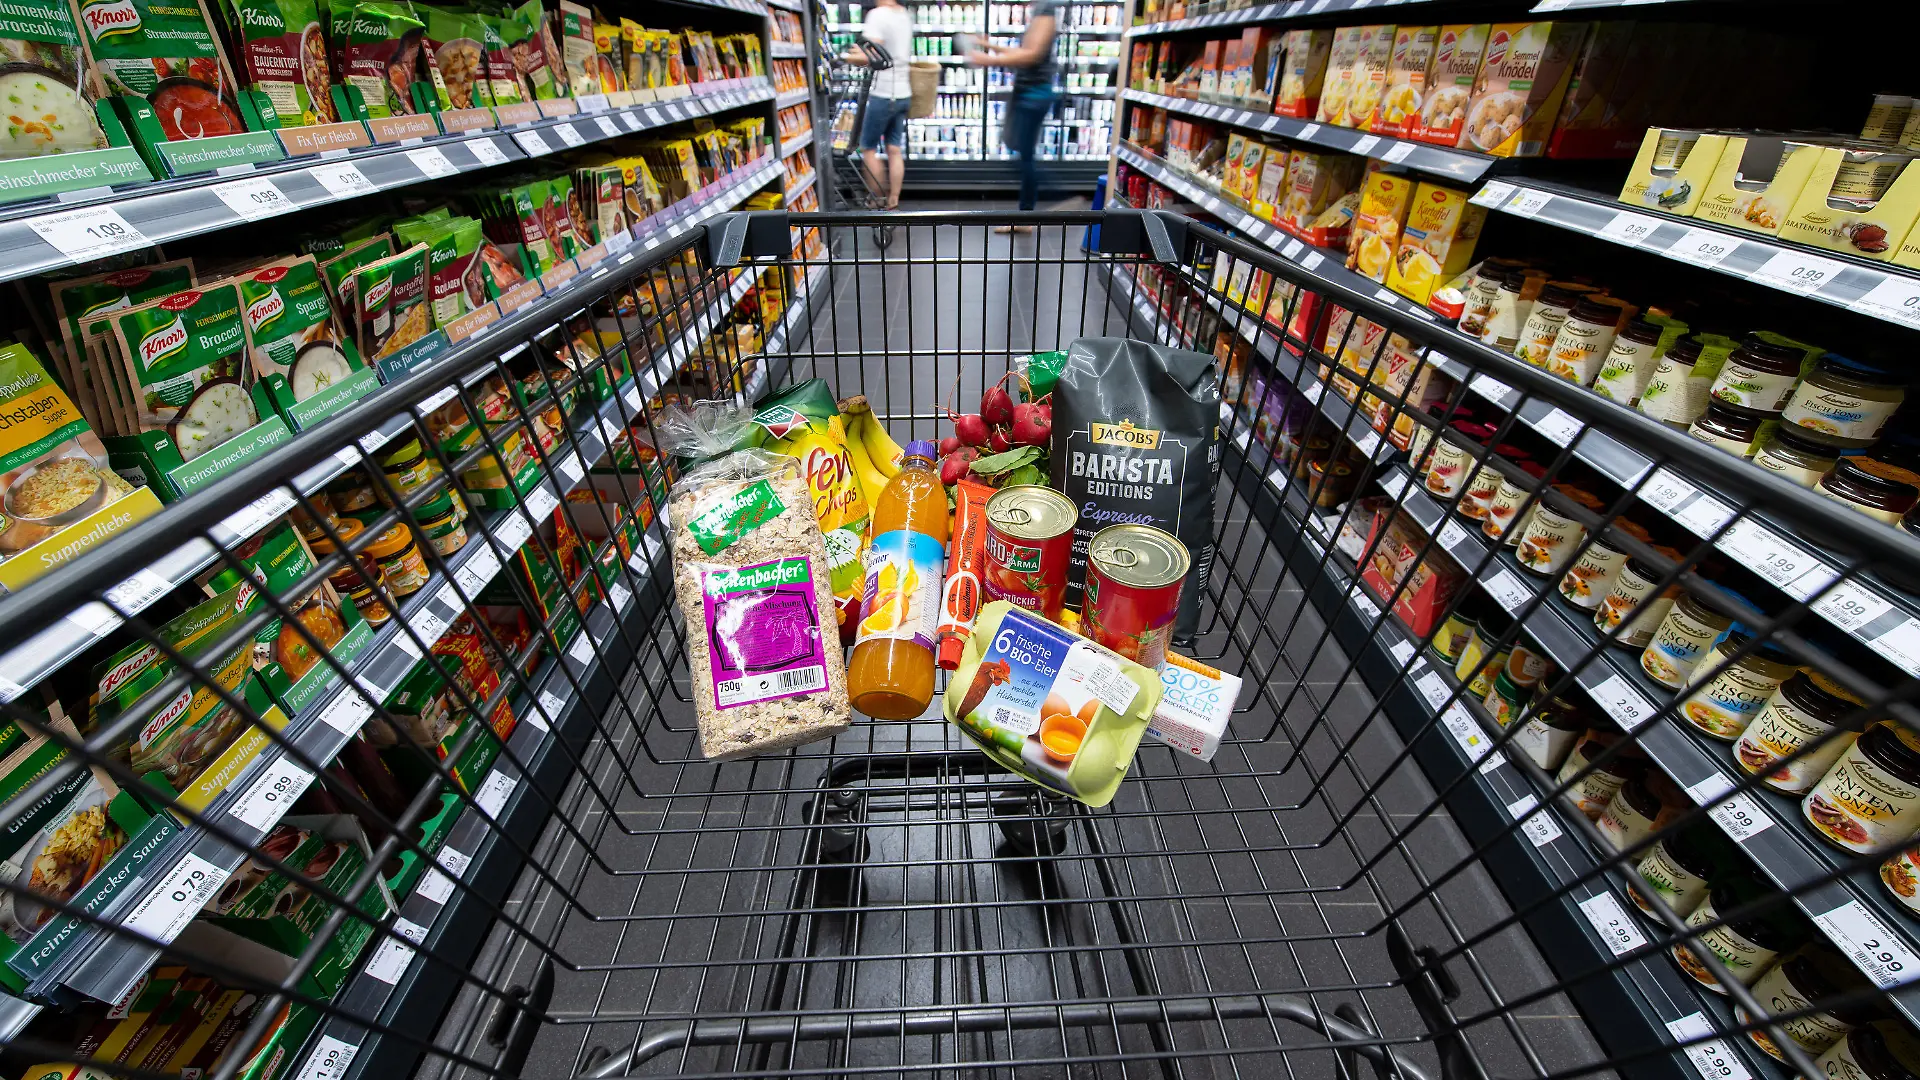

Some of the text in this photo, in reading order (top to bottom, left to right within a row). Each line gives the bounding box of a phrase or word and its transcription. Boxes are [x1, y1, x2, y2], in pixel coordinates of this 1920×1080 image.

[86, 7, 137, 30] Knorr
[242, 8, 285, 29] Knorr
[354, 19, 389, 36] Knorr
[145, 28, 210, 40] Strauchtomaten
[254, 55, 299, 69] BAUERNTOPF
[1402, 57, 1426, 72] Knödel
[1459, 50, 1481, 58] Semmel
[1513, 50, 1540, 60] Semmel
[1448, 60, 1476, 75] Knödel
[1500, 62, 1536, 79] Knödel
[297, 129, 357, 147] Fix für Fleisch
[382, 120, 429, 135] Fix für Fleisch
[171, 142, 277, 166] Feinschmecker Suppe
[0, 160, 142, 191] einschmecker Suppe
[339, 172, 362, 184] 0.79
[251, 190, 279, 204] 0.99
[1417, 201, 1451, 220] Kartoffel
[1700, 202, 1745, 217] KRUSTENTIER-
[1709, 210, 1728, 220] PASTE
[86, 222, 125, 239] 1.09
[1625, 224, 1647, 235] 0.99
[1786, 220, 1843, 237] BRATEN-PASTE
[431, 248, 457, 264] Knorr
[1698, 243, 1725, 256] 0.99
[1791, 266, 1825, 282] 0.99
[367, 281, 392, 304] Knorr
[249, 298, 283, 324] Knorr
[456, 325, 466, 336] Fix
[475, 310, 493, 327] Fleisch
[142, 328, 185, 360] Knorr
[200, 322, 241, 350] Broccoli
[390, 338, 439, 374] Fix für Gemüse
[1739, 380, 1763, 392] FOND
[299, 375, 375, 425] Feinschmecker Suppe
[1804, 398, 1862, 421] FISCH FOND
[42, 407, 68, 425] Suppe
[6, 457, 19, 466] mit
[20, 446, 41, 461] vielen
[67, 424, 80, 435] A-Z
[1096, 426, 1154, 446] JACOBS
[182, 425, 285, 487] Feinschmecker Suppe
[1072, 451, 1174, 486] BARISTA
[1087, 480, 1154, 500] EDITIONS
[1655, 484, 1678, 500] 1.99
[816, 486, 857, 520] Chips
[1081, 501, 1155, 526] Espresso
[41, 510, 133, 569] Suppenliebe
[1766, 552, 1796, 573] 1.99
[462, 573, 477, 588] 1.79
[763, 600, 802, 613] Mischung
[1003, 592, 1036, 605] STÜCKIG
[1507, 591, 1523, 606] 2.99
[1832, 594, 1866, 615] 1.99
[421, 615, 438, 632] 1.79
[995, 629, 1052, 660] 6 frische
[1657, 633, 1687, 658] FOND
[1660, 621, 1701, 655] FISCH
[102, 646, 158, 692] Knorr
[1010, 647, 1056, 678] BIO-Eier
[719, 680, 741, 693] 750g
[1032, 680, 1046, 691] dem
[1161, 667, 1224, 704] 30%
[1709, 677, 1767, 706] FISCH
[1617, 698, 1639, 719] 2.99
[1710, 689, 1751, 712] FOND
[143, 692, 191, 739] Knorr
[201, 731, 266, 796] Suppenliebe
[473, 748, 490, 774] Soße
[67, 770, 87, 792] Sauce
[265, 776, 292, 802] 0.89
[495, 775, 508, 792] 1.29
[1834, 764, 1904, 818] ENTEN
[1833, 783, 1878, 818] FOND
[1723, 802, 1753, 828] 2.99
[1530, 817, 1548, 836] 2.99
[133, 825, 171, 864] Sauce
[172, 870, 205, 902] 0.79
[1609, 919, 1631, 944] 2.99
[1863, 938, 1904, 973] 2.99
[316, 1050, 340, 1079] 1.99
[1704, 1046, 1732, 1078] 2.99
